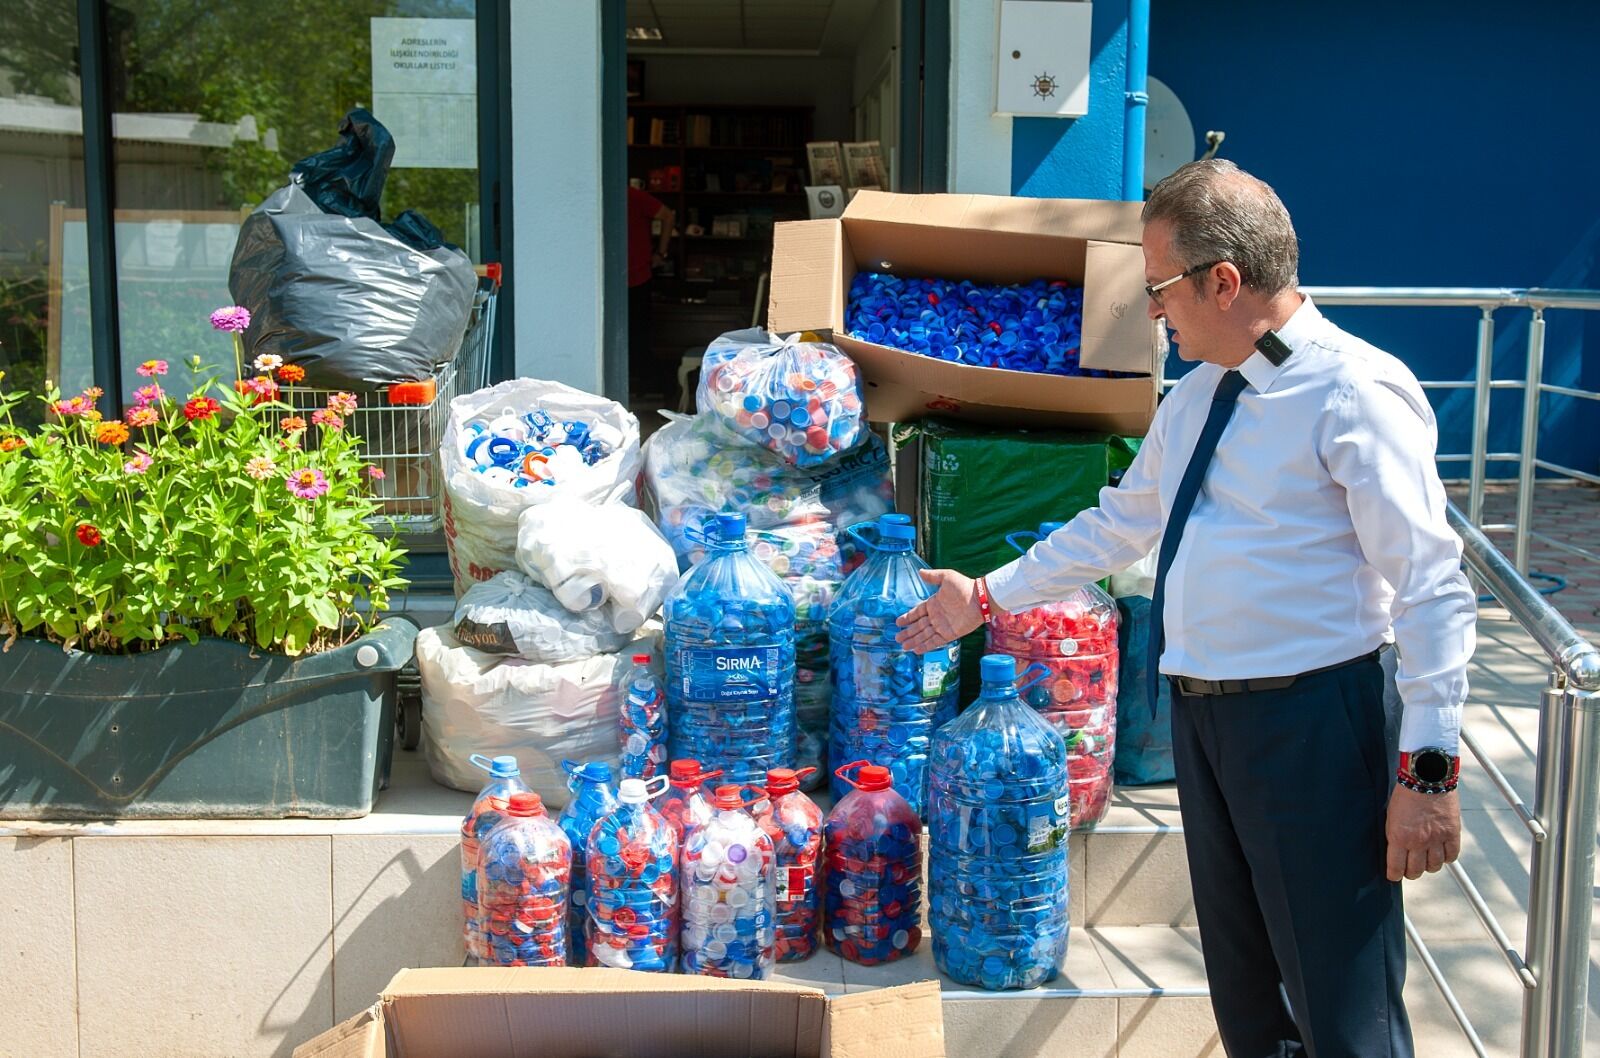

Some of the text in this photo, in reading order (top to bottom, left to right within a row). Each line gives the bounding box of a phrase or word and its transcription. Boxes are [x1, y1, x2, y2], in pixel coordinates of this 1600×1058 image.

[401, 37, 447, 46] ADRESLERİN
[393, 62, 428, 70] OKULLAR
[716, 656, 763, 670] SIRMA
